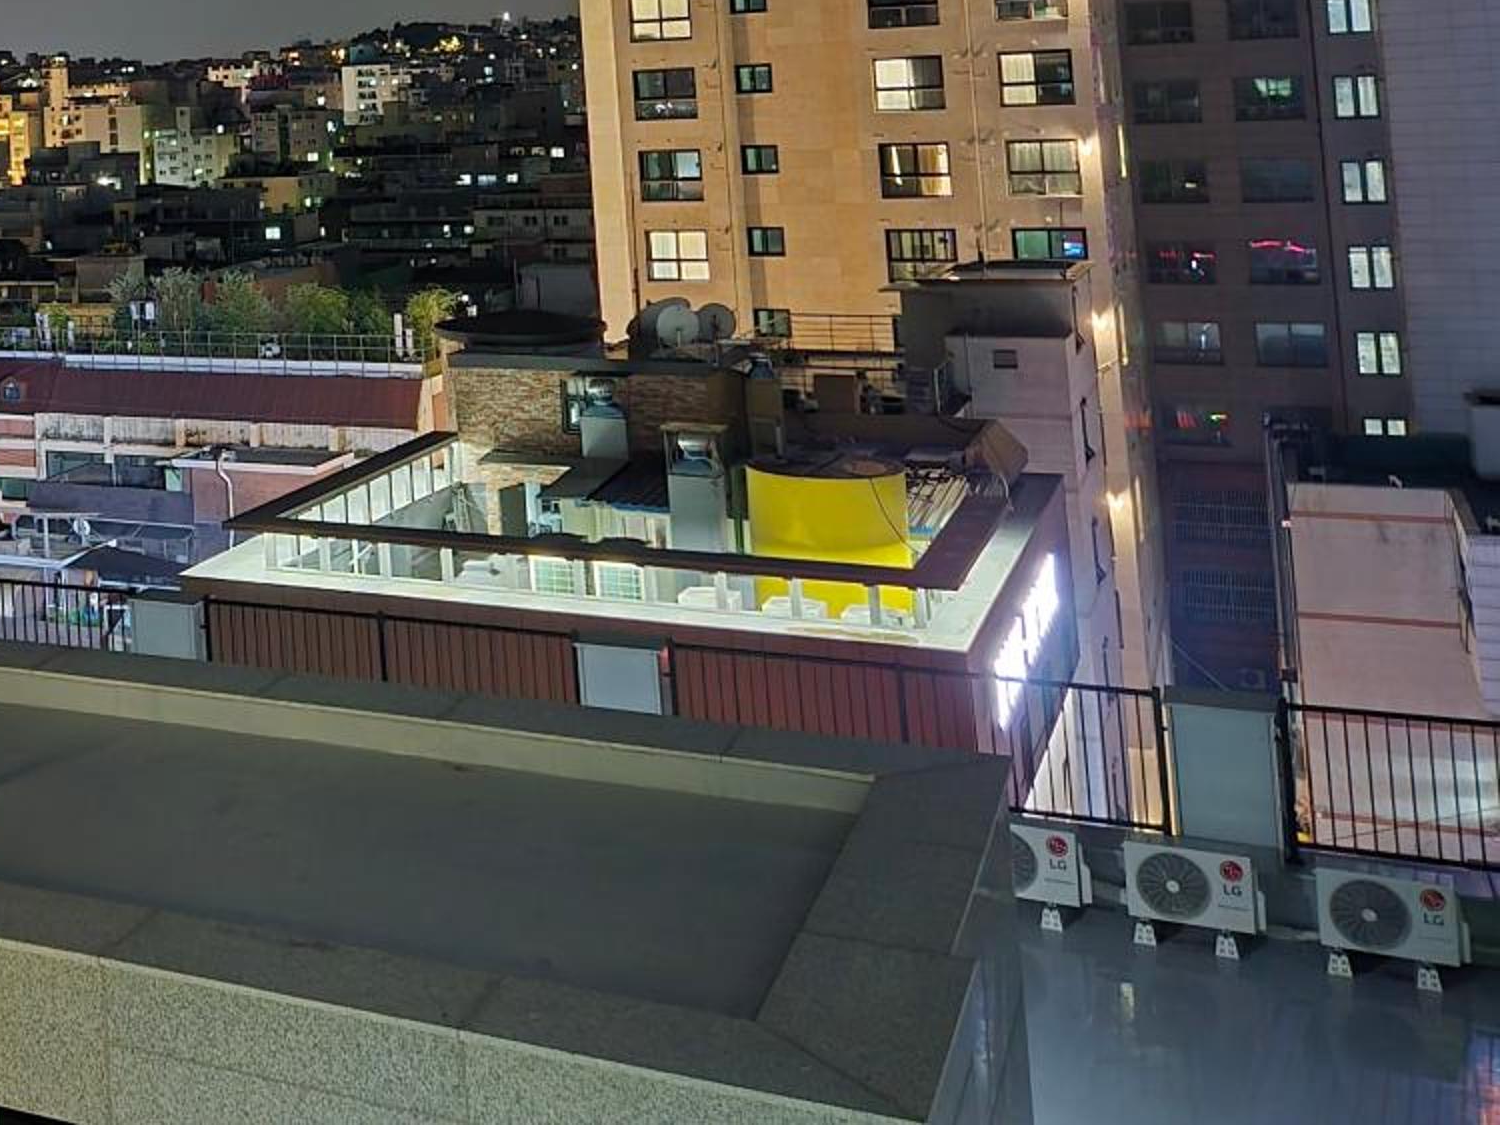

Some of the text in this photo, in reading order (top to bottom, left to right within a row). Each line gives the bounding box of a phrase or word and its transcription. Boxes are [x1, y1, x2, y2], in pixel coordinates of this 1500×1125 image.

[1049, 858, 1067, 872] LG
[1223, 884, 1242, 897] LG
[1423, 912, 1444, 926] LG
